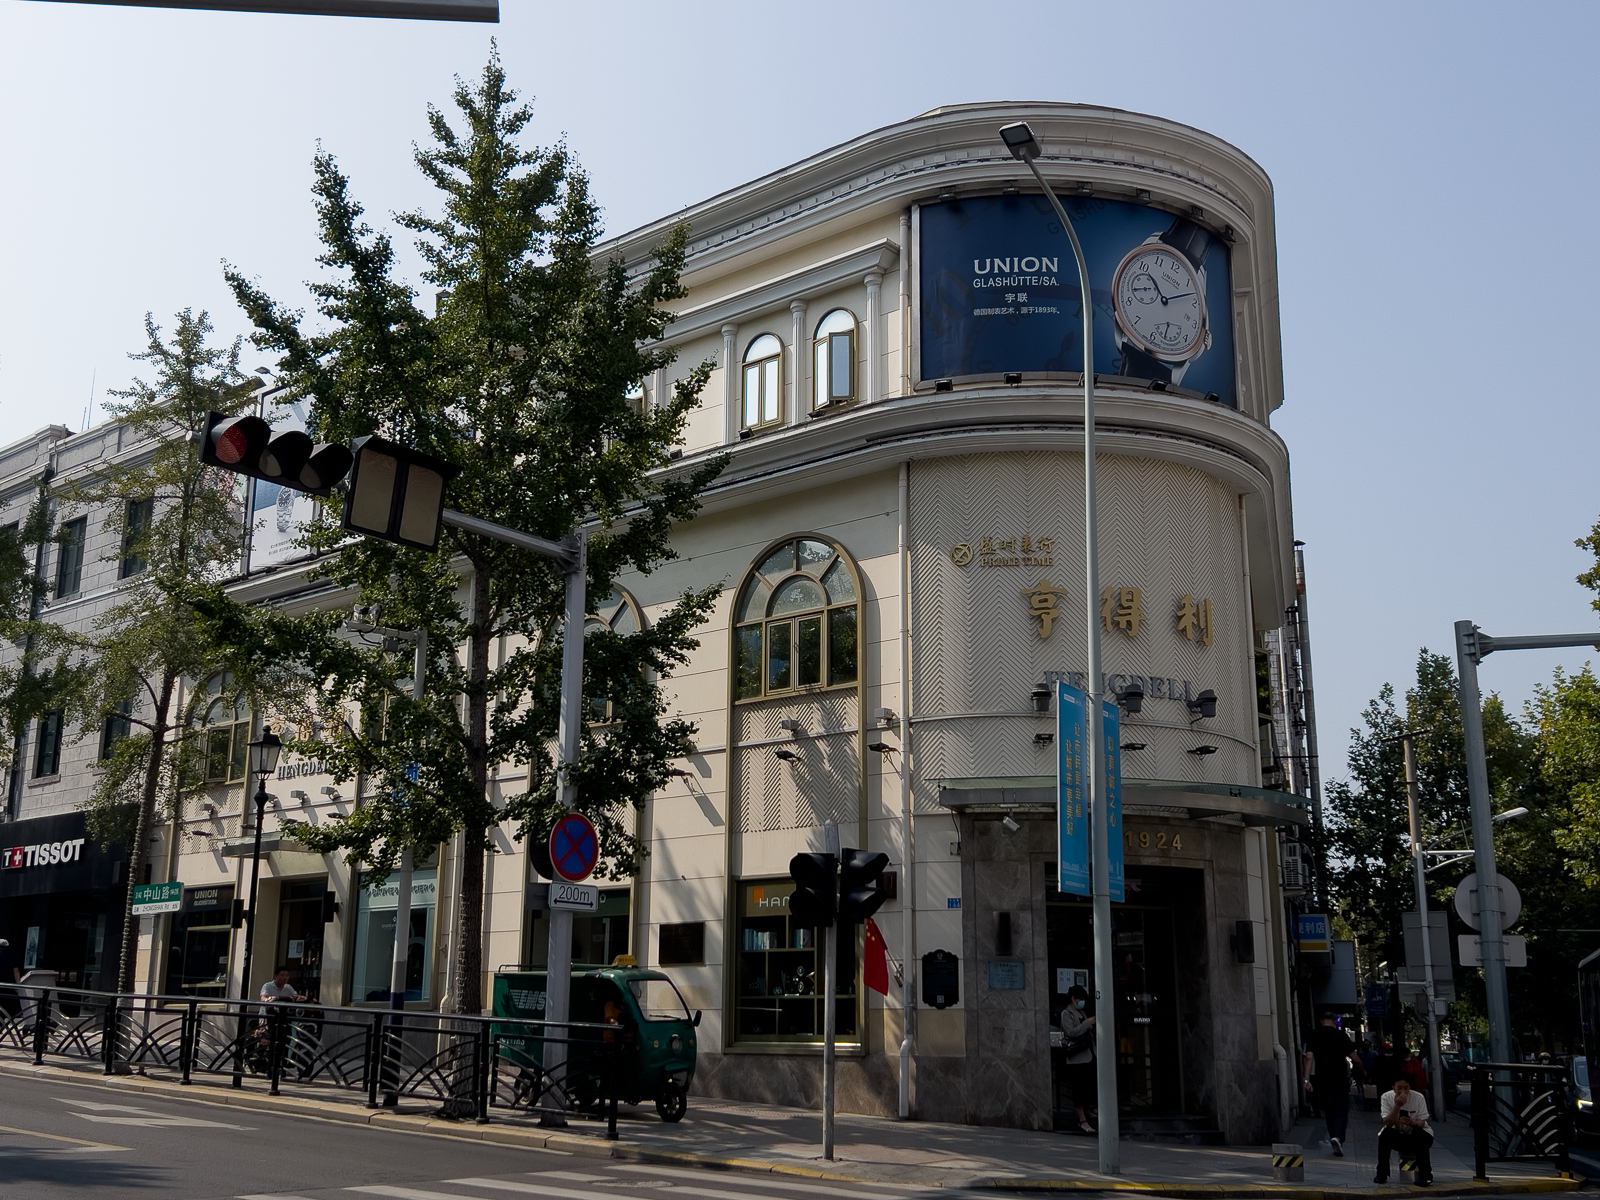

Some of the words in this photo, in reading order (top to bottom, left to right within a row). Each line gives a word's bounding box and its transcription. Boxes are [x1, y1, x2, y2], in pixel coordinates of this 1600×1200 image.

[974, 257, 1058, 274] UNION
[973, 275, 1059, 289] GLASHÜTTE/SA.
[1005, 292, 1028, 303] 宇联
[980, 534, 1055, 555] 盛时表行
[980, 557, 1019, 567] PRIME
[1023, 557, 1053, 566] TIME
[1020, 578, 1213, 646] 亨得利
[1044, 671, 1192, 701] HEGDELI
[1124, 831, 1182, 851] 1924
[24, 838, 85, 867] TISSOT
[143, 886, 170, 902] 中山路
[194, 889, 218, 899] UNION
[558, 885, 590, 902] 200m
